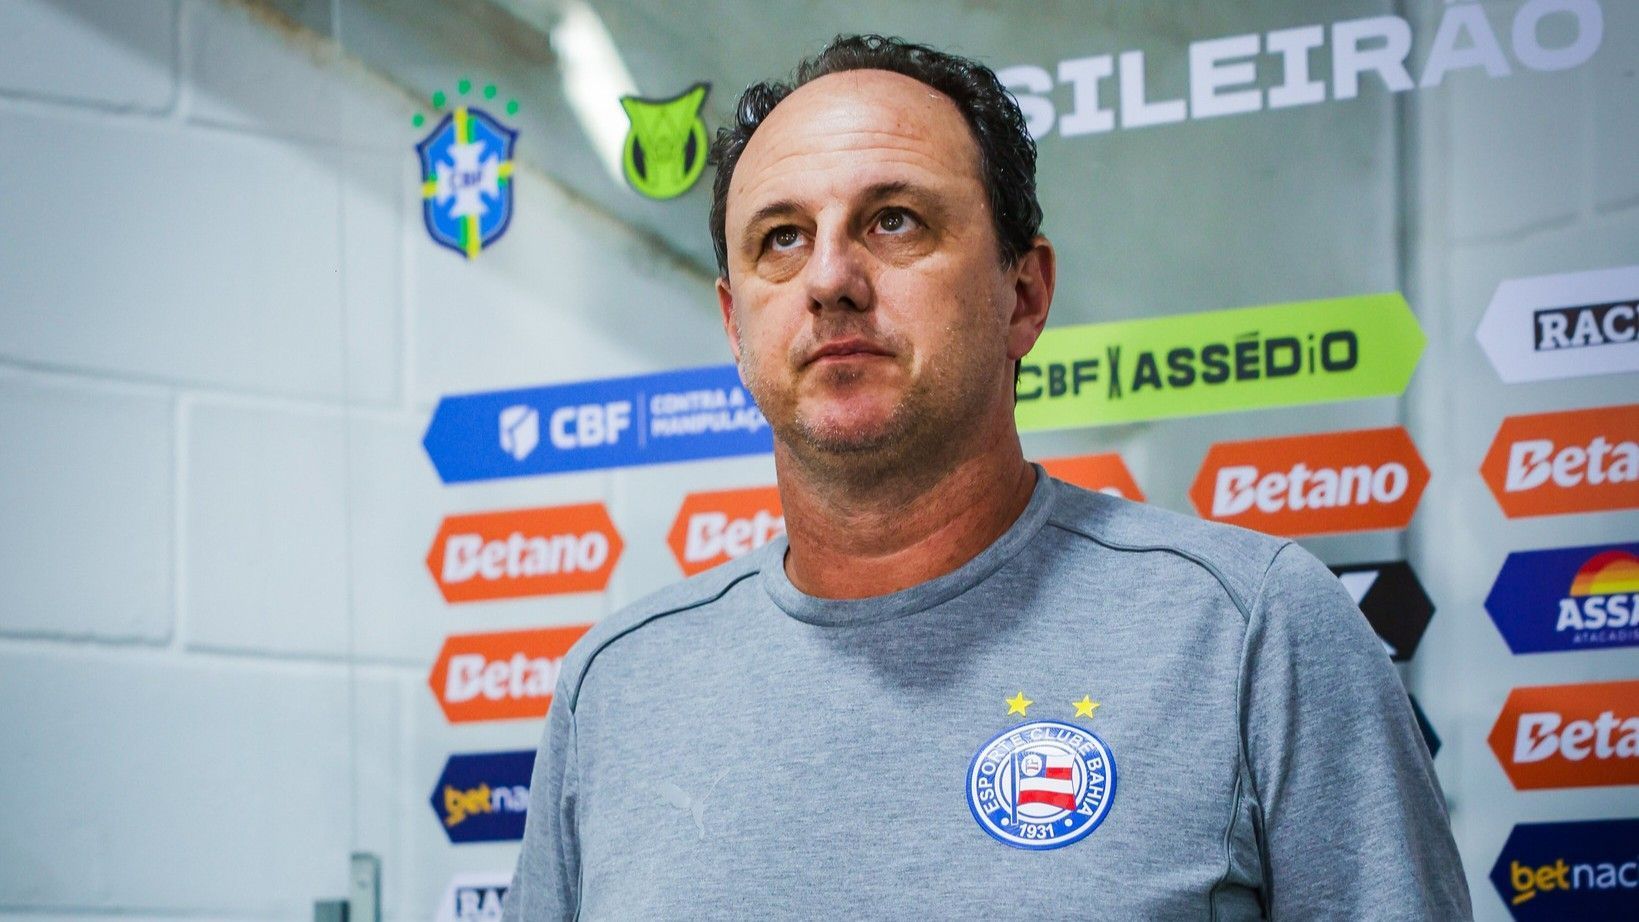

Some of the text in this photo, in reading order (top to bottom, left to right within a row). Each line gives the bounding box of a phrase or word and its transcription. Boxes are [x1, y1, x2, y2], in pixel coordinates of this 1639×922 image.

[1538, 305, 1639, 350] RAC
[1016, 359, 1099, 401] CBF
[551, 402, 632, 449] CBF
[1211, 462, 1409, 516] Betano
[1505, 436, 1639, 492] Beta
[442, 531, 609, 583] Betano
[684, 509, 787, 562] Bet
[1513, 711, 1639, 764] Beta
[978, 728, 1105, 817] ESPORTE CLUBE BAHIA
[1019, 823, 1055, 839] 1931
